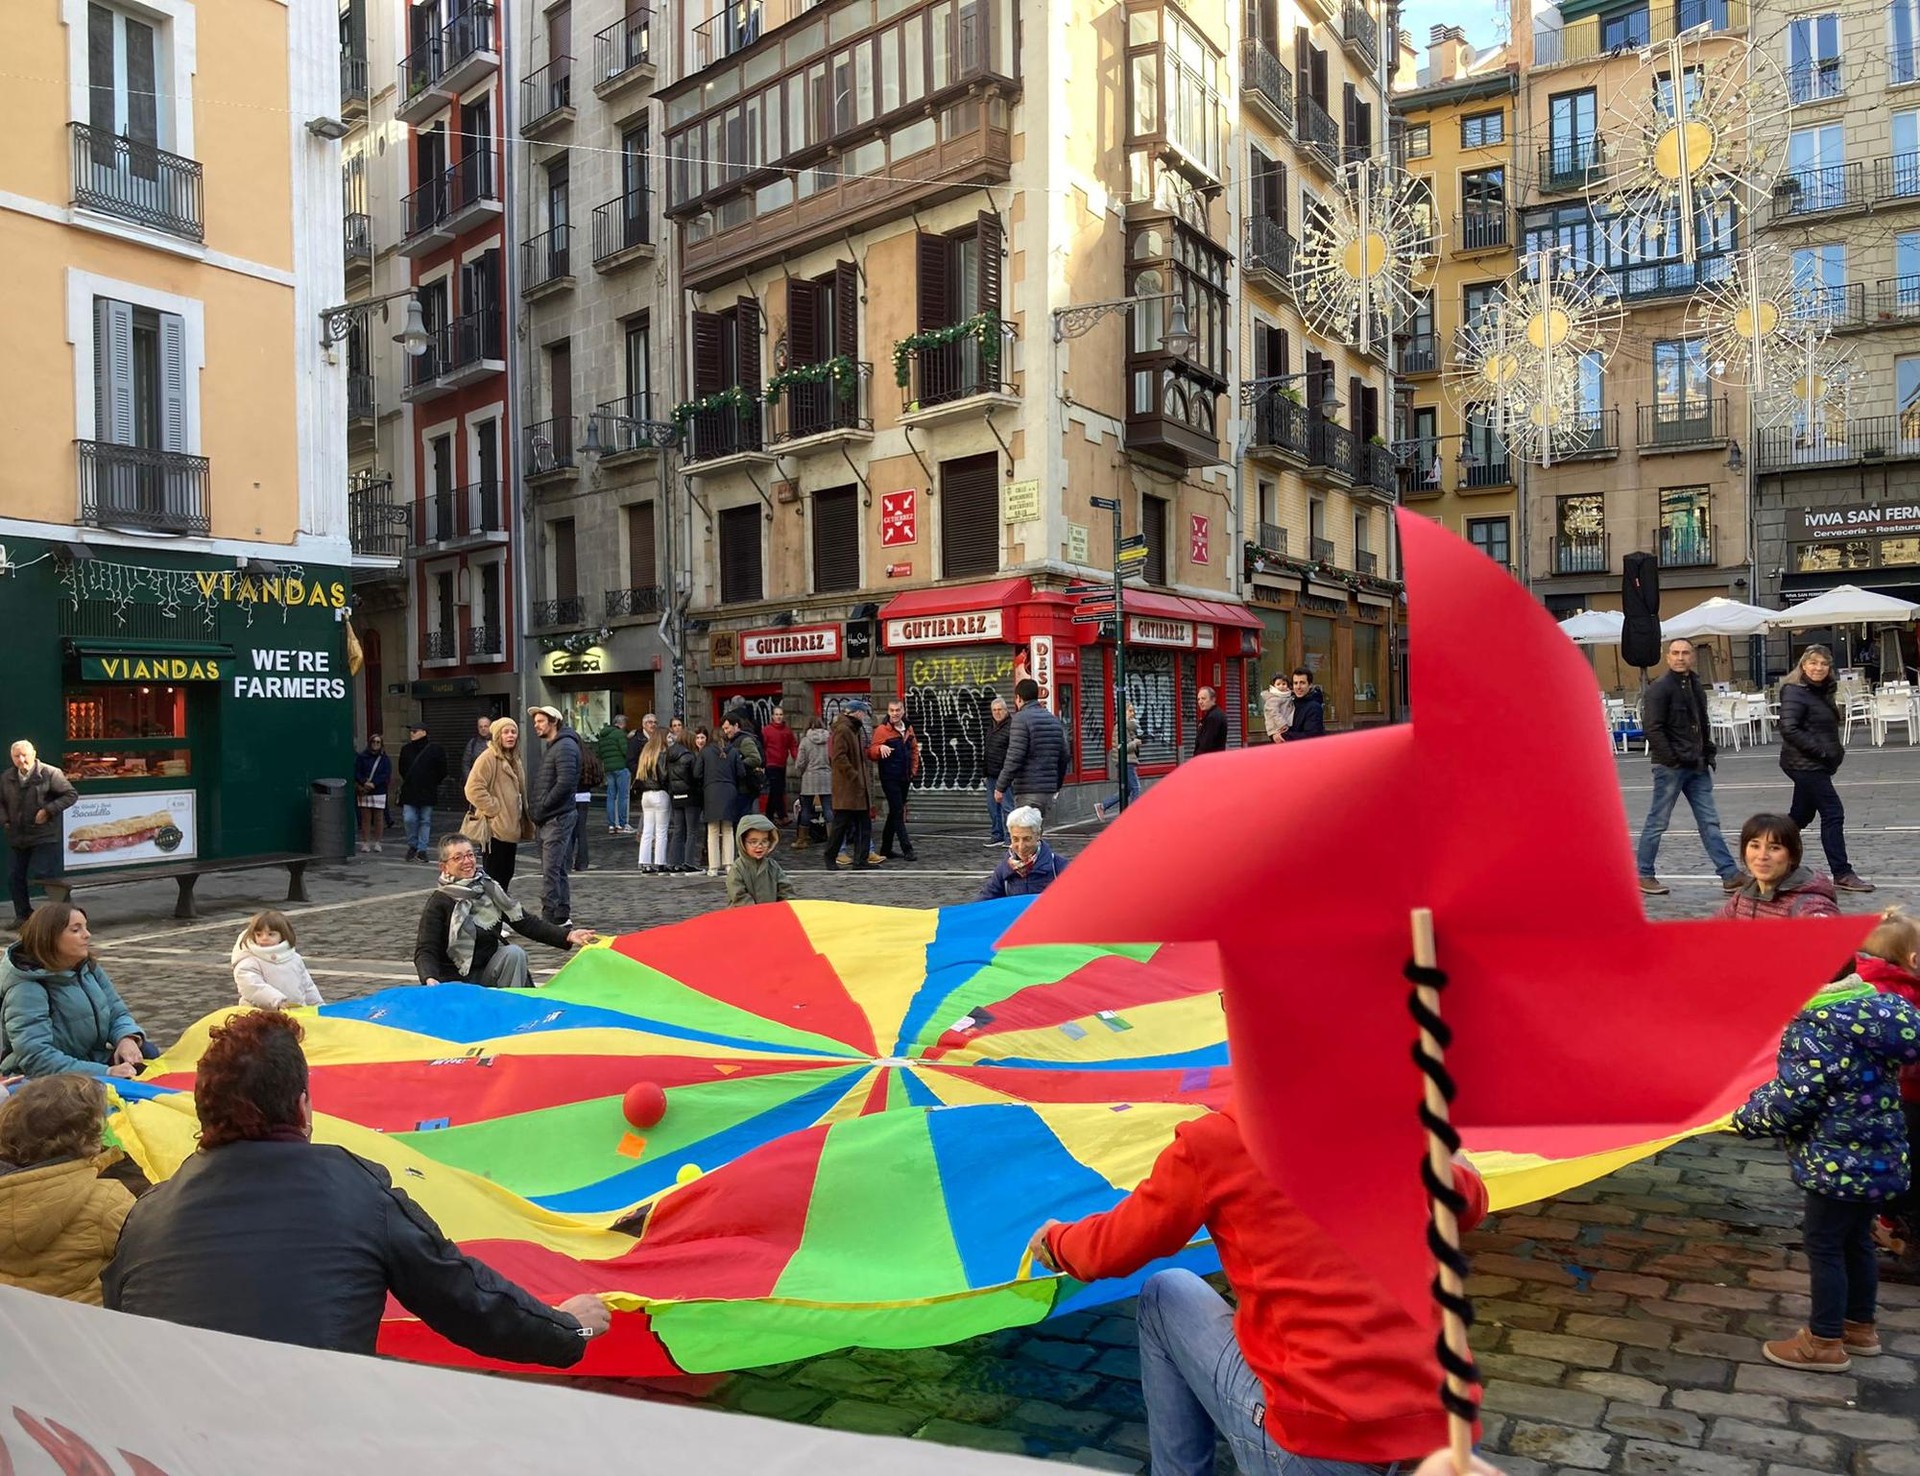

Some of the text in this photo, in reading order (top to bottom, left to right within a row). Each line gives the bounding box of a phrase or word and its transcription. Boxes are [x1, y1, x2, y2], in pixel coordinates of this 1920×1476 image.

[1847, 509, 1880, 523] SAN
[1814, 527, 1867, 537] Cervecería
[196, 571, 345, 607] VIANDAS
[903, 615, 986, 640] GUTIERREZ
[1138, 621, 1185, 641] GUTIERREZ
[756, 634, 825, 655] GUTIERREZ
[101, 658, 219, 680] VIANDAS
[234, 676, 346, 699] FARMERS
